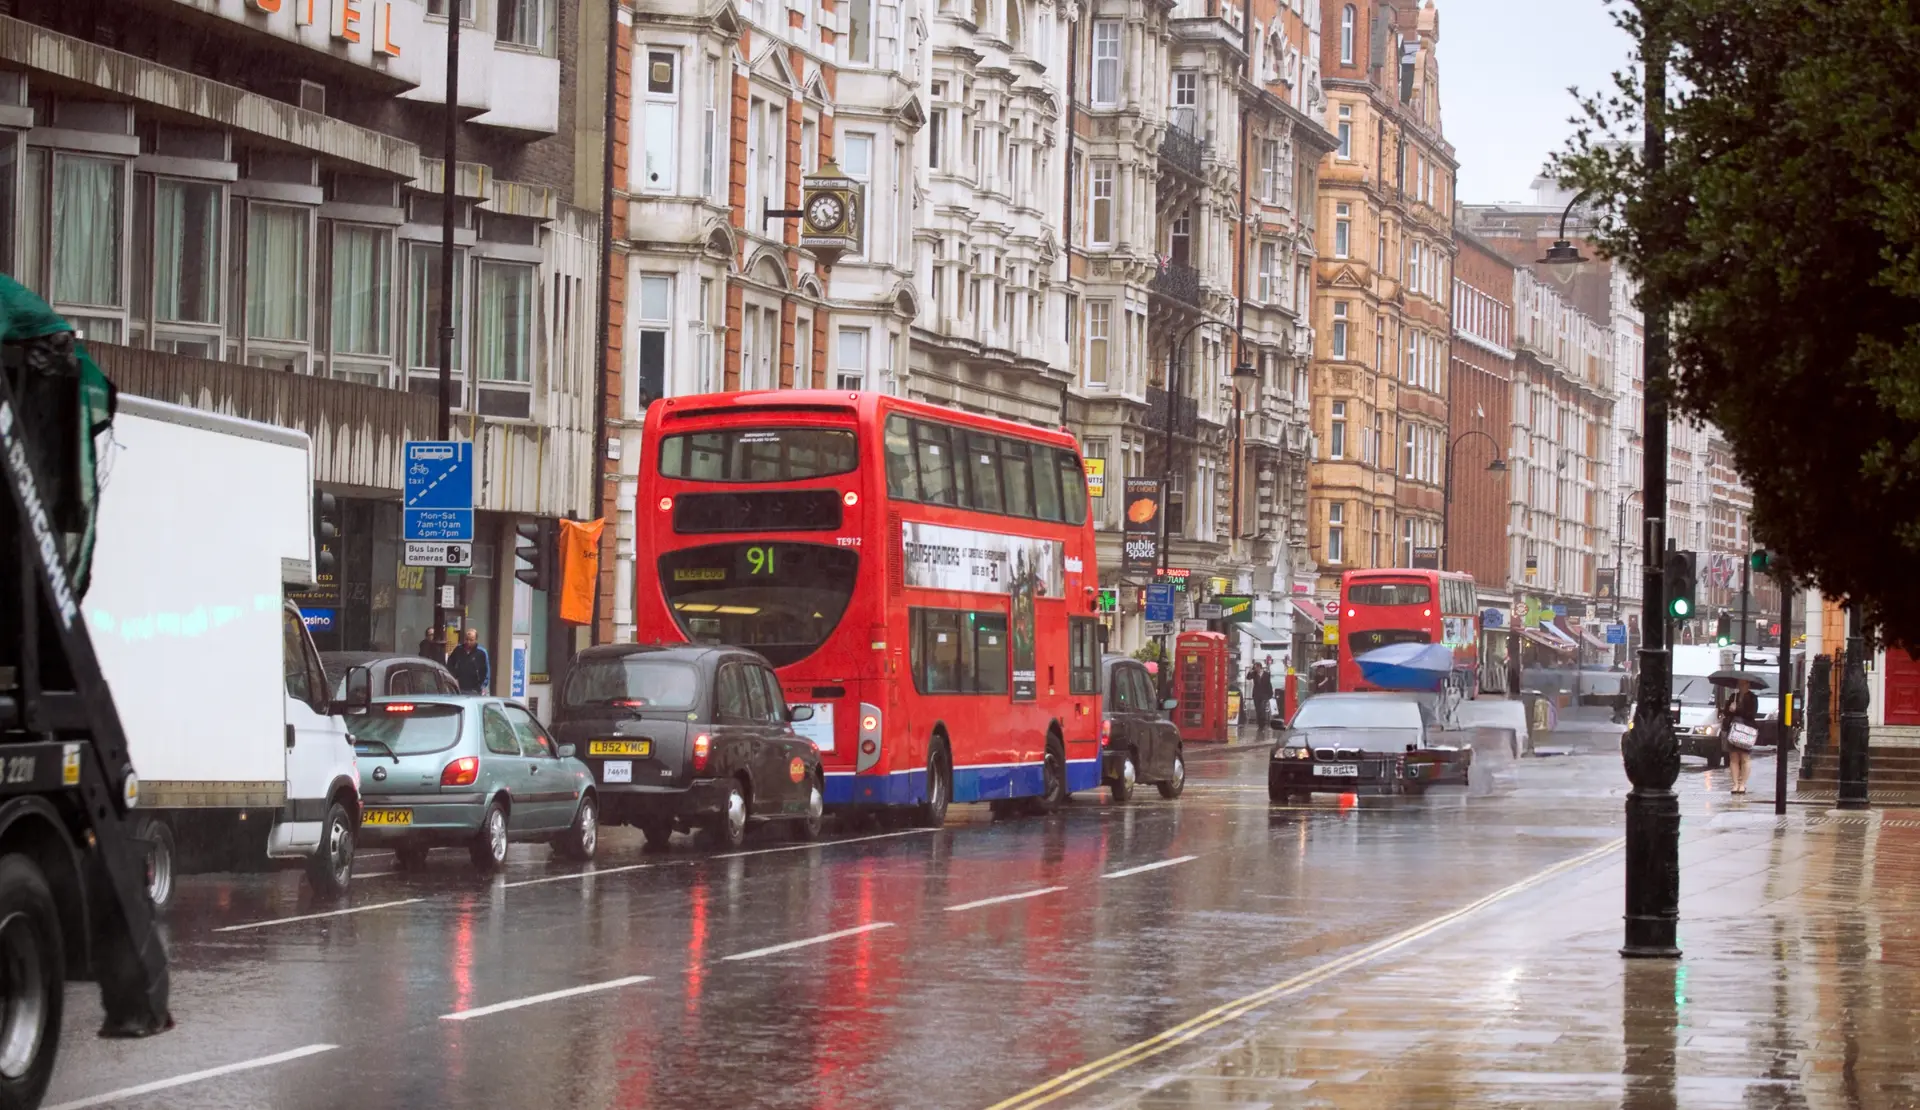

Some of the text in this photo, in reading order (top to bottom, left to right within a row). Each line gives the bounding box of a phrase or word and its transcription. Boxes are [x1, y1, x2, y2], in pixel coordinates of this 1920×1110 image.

[408, 477, 425, 485] taxi
[420, 512, 456, 520] Mon-Sat
[836, 537, 862, 546] TE912
[1126, 540, 1155, 552] public
[408, 544, 445, 553] Bus lane
[1128, 548, 1155, 559] space
[408, 554, 444, 562] cameras
[746, 547, 775, 575] 91
[1223, 602, 1251, 617] UBWAY
[304, 614, 330, 625] asino
[1371, 633, 1382, 643] 91
[387, 811, 410, 823] GKX
